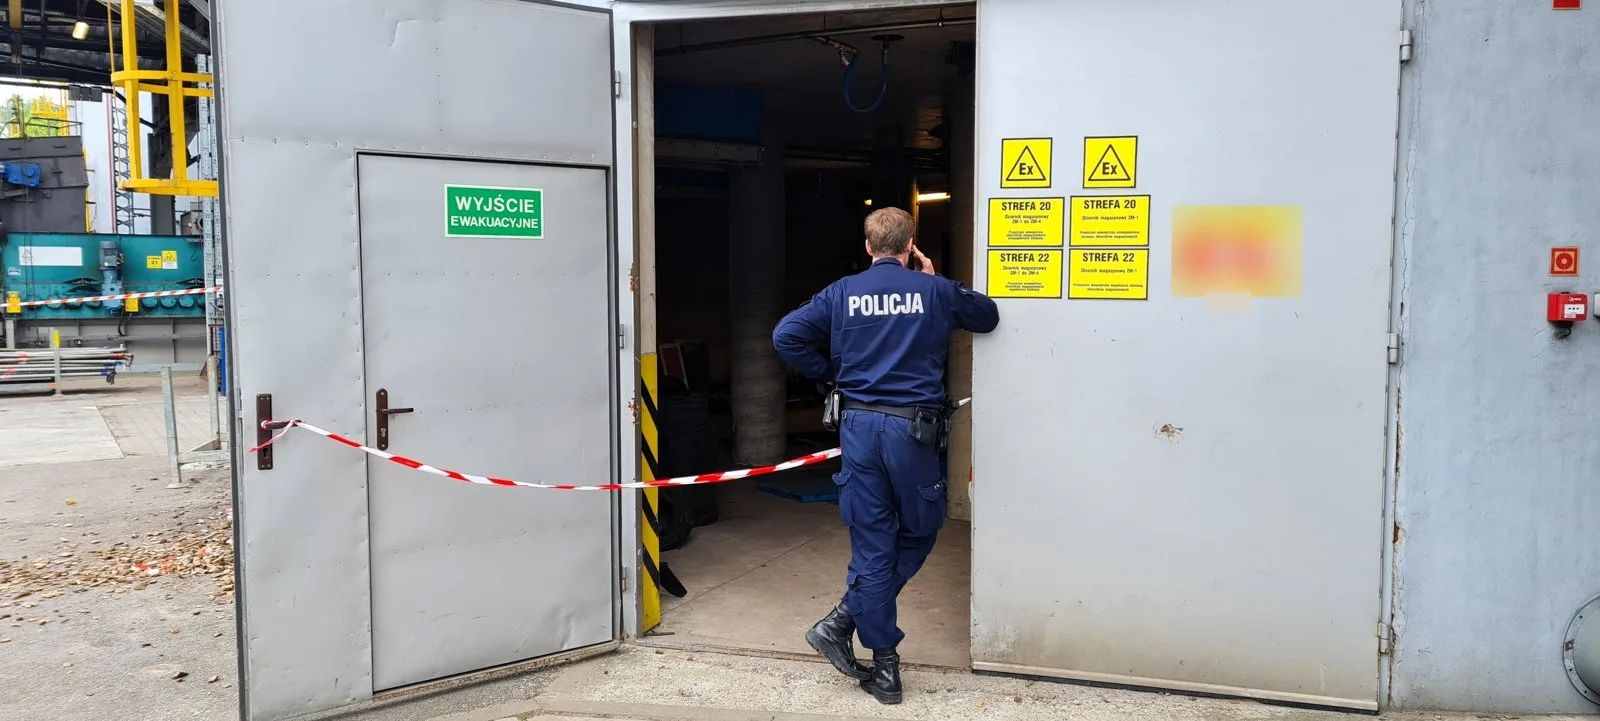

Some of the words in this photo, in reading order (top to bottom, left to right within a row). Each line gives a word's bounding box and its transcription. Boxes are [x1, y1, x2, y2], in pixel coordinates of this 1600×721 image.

[1019, 163, 1034, 175] Ex
[1102, 162, 1117, 175] Ex
[455, 194, 535, 213] WYJŚCIE
[1001, 201, 1036, 211] STREFA
[1039, 201, 1051, 211] 20
[1083, 199, 1120, 209] STREFA
[1124, 199, 1136, 209] 20
[450, 216, 539, 229] EWAKUACYJNE
[1000, 253, 1035, 262] STREFA
[1038, 253, 1050, 262] 22
[1082, 252, 1119, 262] STREFA
[1122, 252, 1135, 262] 22
[848, 292, 924, 316] POLICJA
